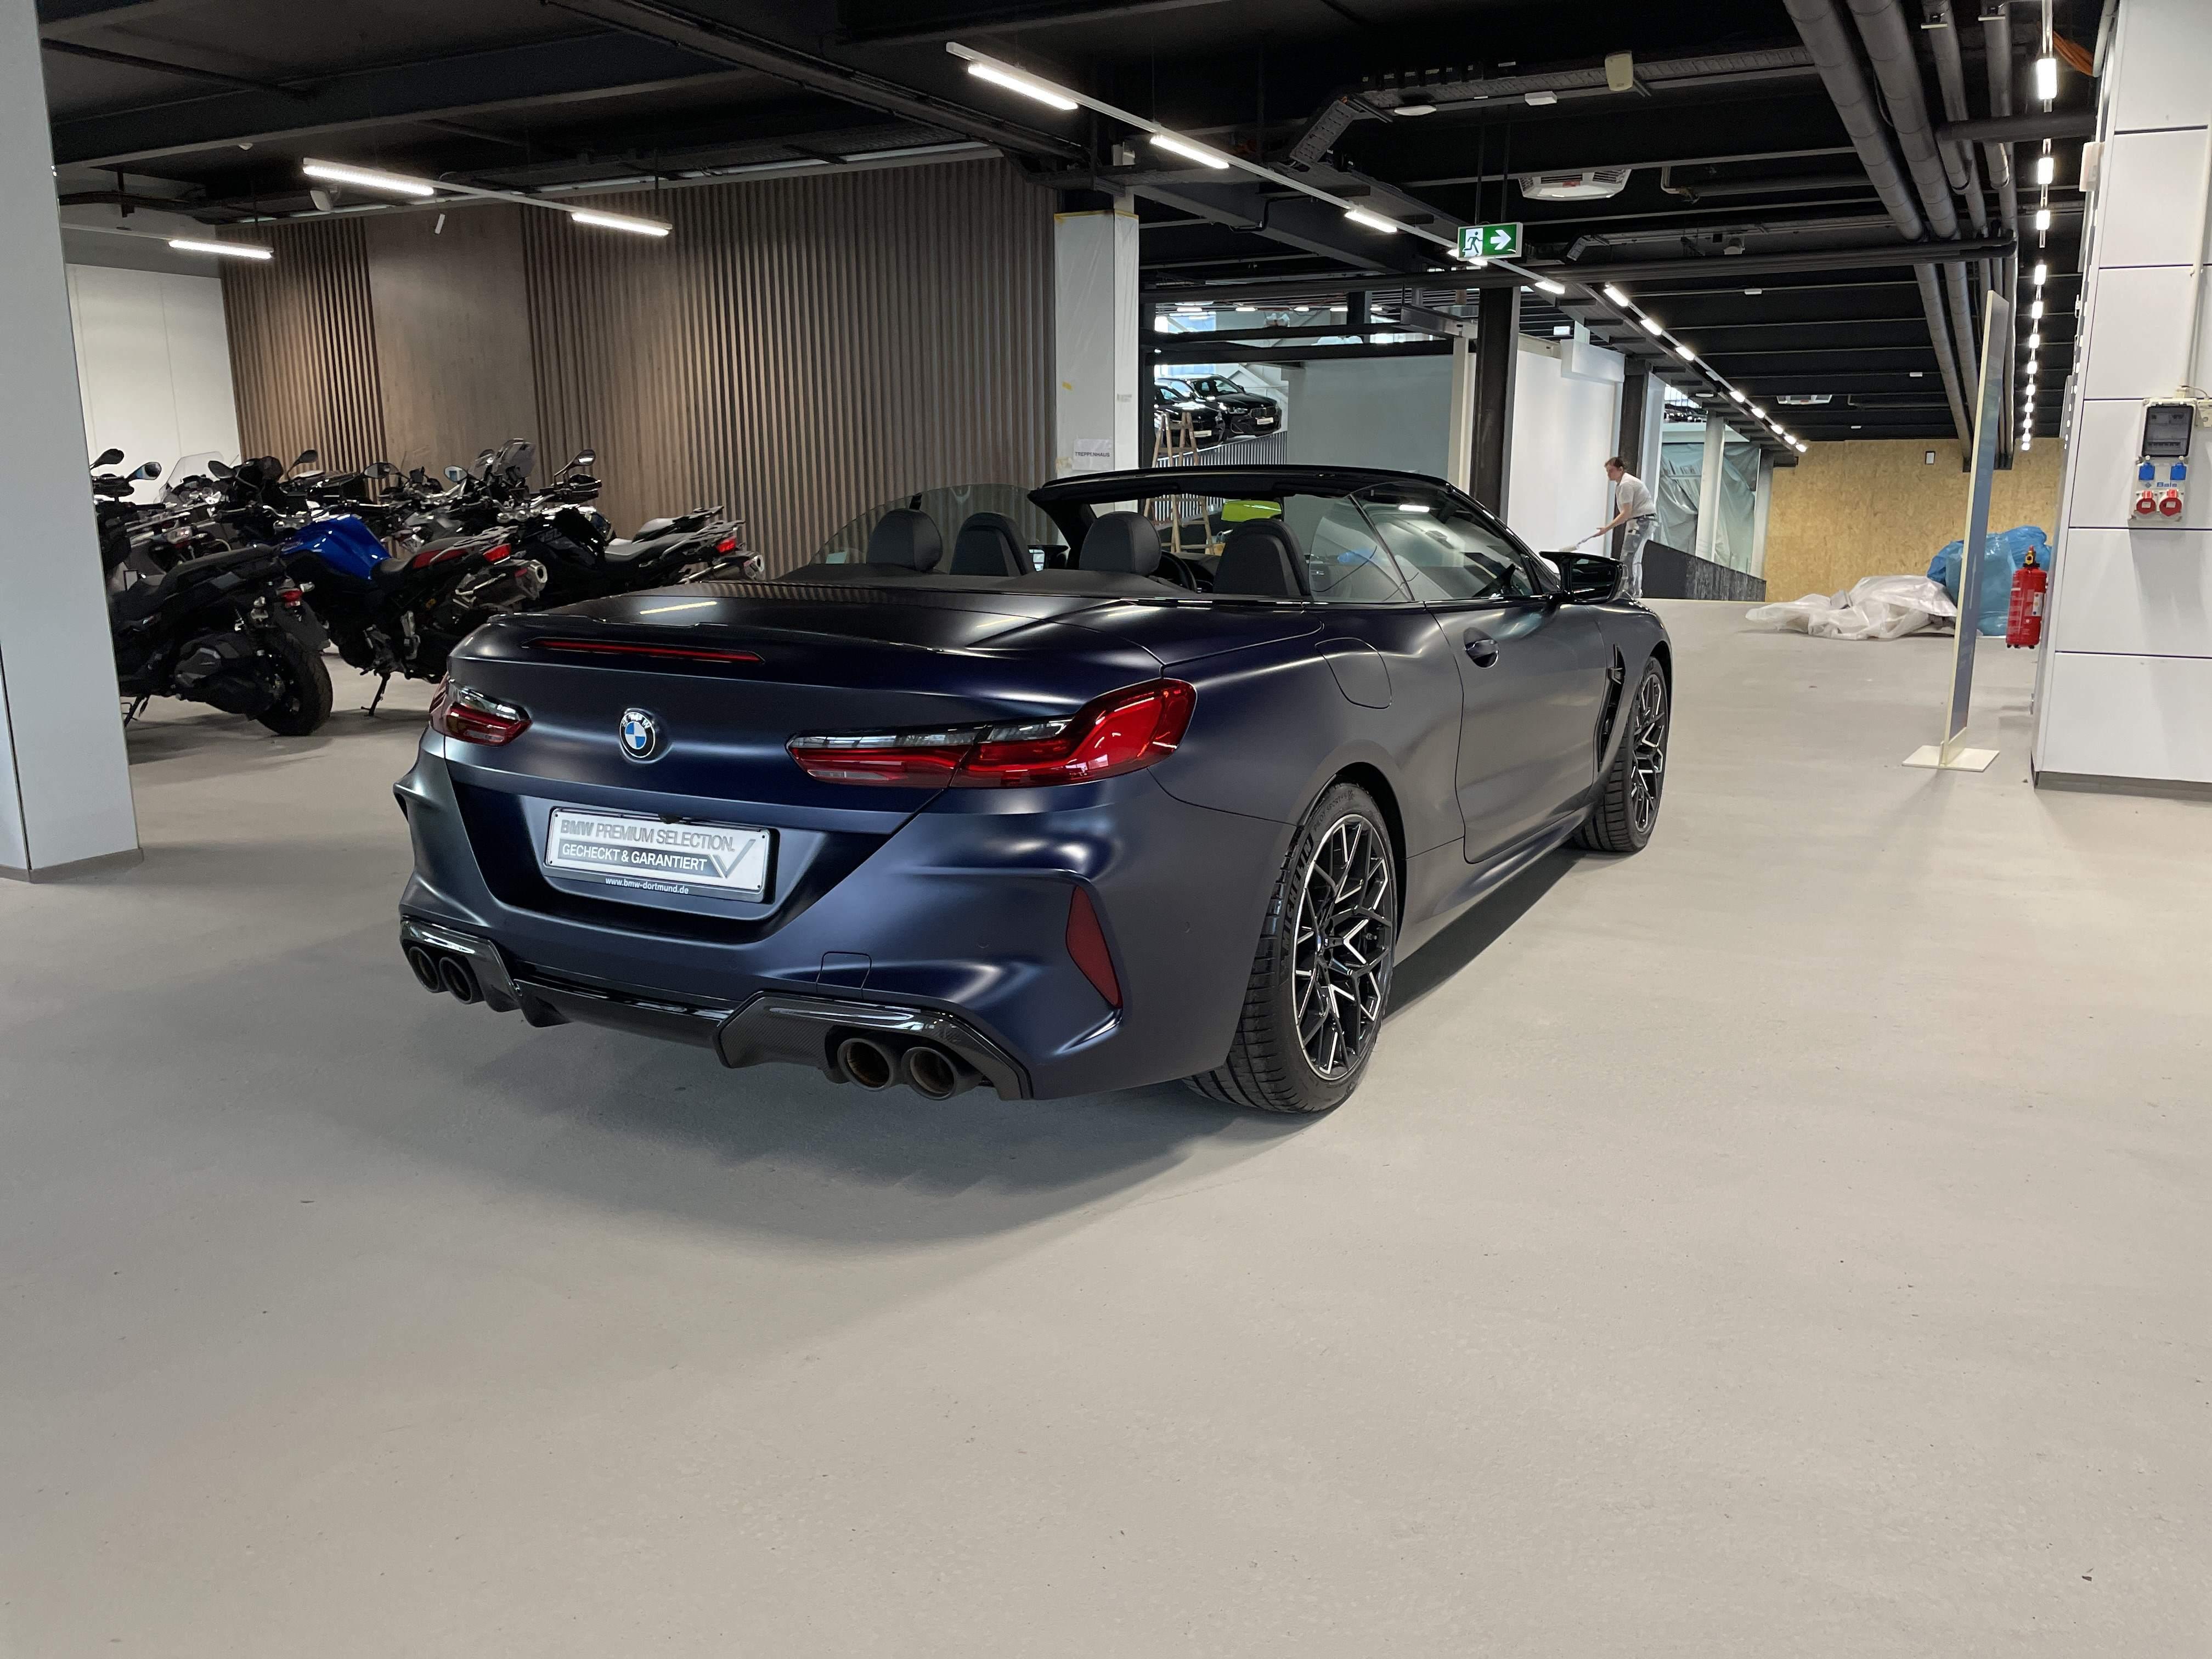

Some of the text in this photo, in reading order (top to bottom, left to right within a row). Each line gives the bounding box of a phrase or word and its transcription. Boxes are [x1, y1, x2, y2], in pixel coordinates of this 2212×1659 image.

[622, 714, 651, 729] BMW
[560, 819, 594, 836] BMW
[595, 823, 654, 843] PREMIUM
[562, 843, 707, 871] GECHECKT & GARANTIERT
[605, 877, 689, 895] www.bmw-dortmund.de
[1282, 833, 1314, 951] MICHELIN
